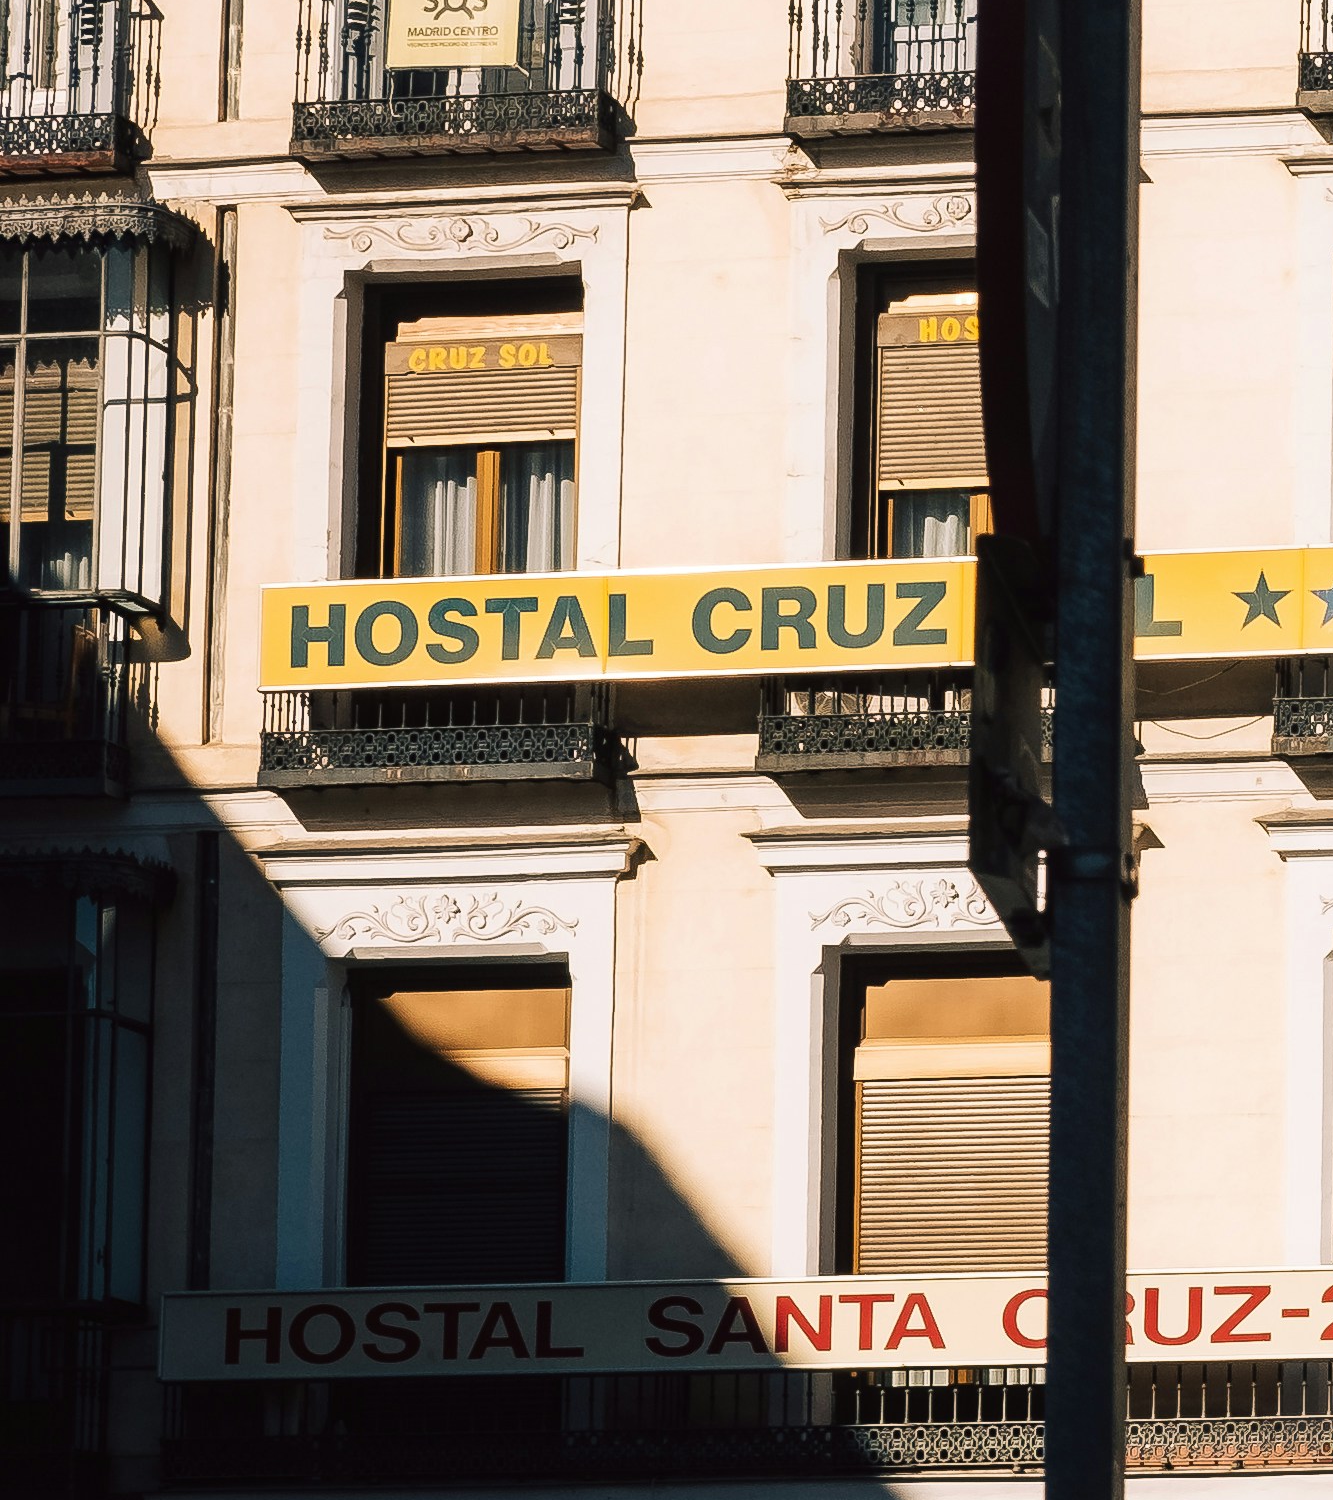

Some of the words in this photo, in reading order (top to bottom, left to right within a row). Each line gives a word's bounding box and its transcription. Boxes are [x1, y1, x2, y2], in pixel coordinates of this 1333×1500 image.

[407, 27, 451, 37] MADRID
[453, 26, 498, 36] CENTRO
[920, 317, 978, 343] HOS
[409, 345, 486, 371] CRUZ
[499, 342, 554, 368] SOL
[290, 592, 653, 668] HOSTAL
[692, 581, 948, 655] CRUZ
[223, 1301, 584, 1366] HOSTAL
[644, 1294, 947, 1357] SANTA
